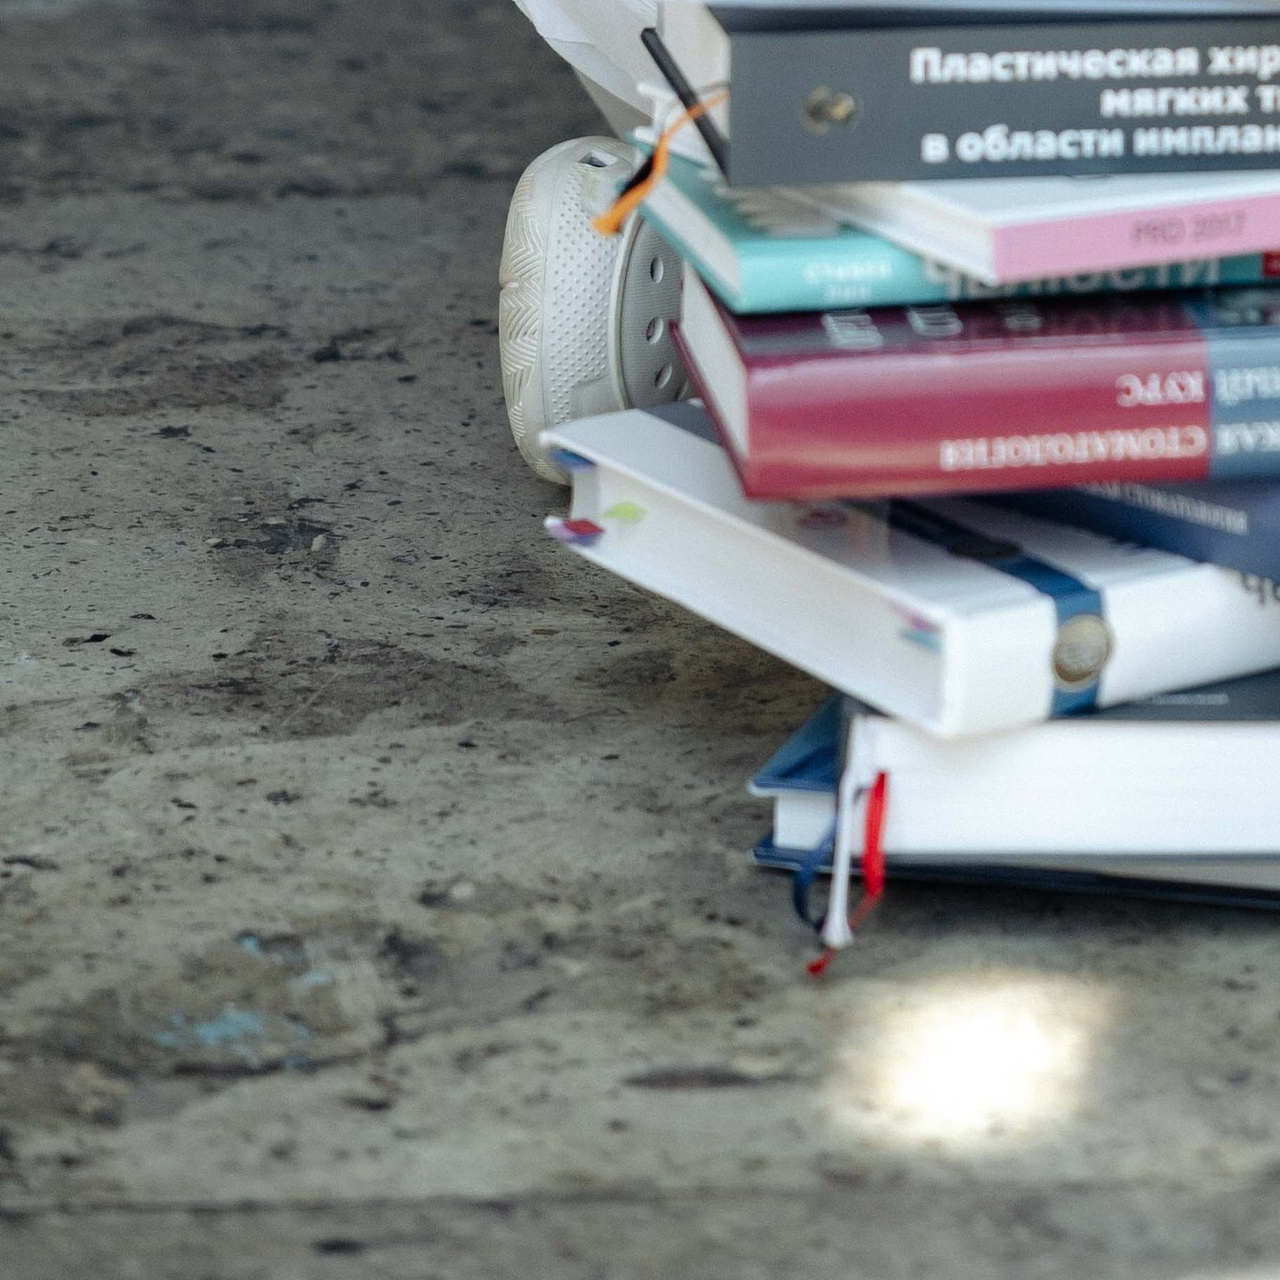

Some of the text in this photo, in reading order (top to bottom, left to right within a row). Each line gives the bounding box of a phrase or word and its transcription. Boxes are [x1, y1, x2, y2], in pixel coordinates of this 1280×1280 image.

[910, 46, 1198, 85] Пластическая
[1101, 87, 1249, 118] мягких
[921, 133, 949, 164] в
[955, 123, 1125, 162] области
[1116, 371, 1205, 407] КУРС
[939, 425, 1207, 471] СТОМАТОЛОГИЯ
